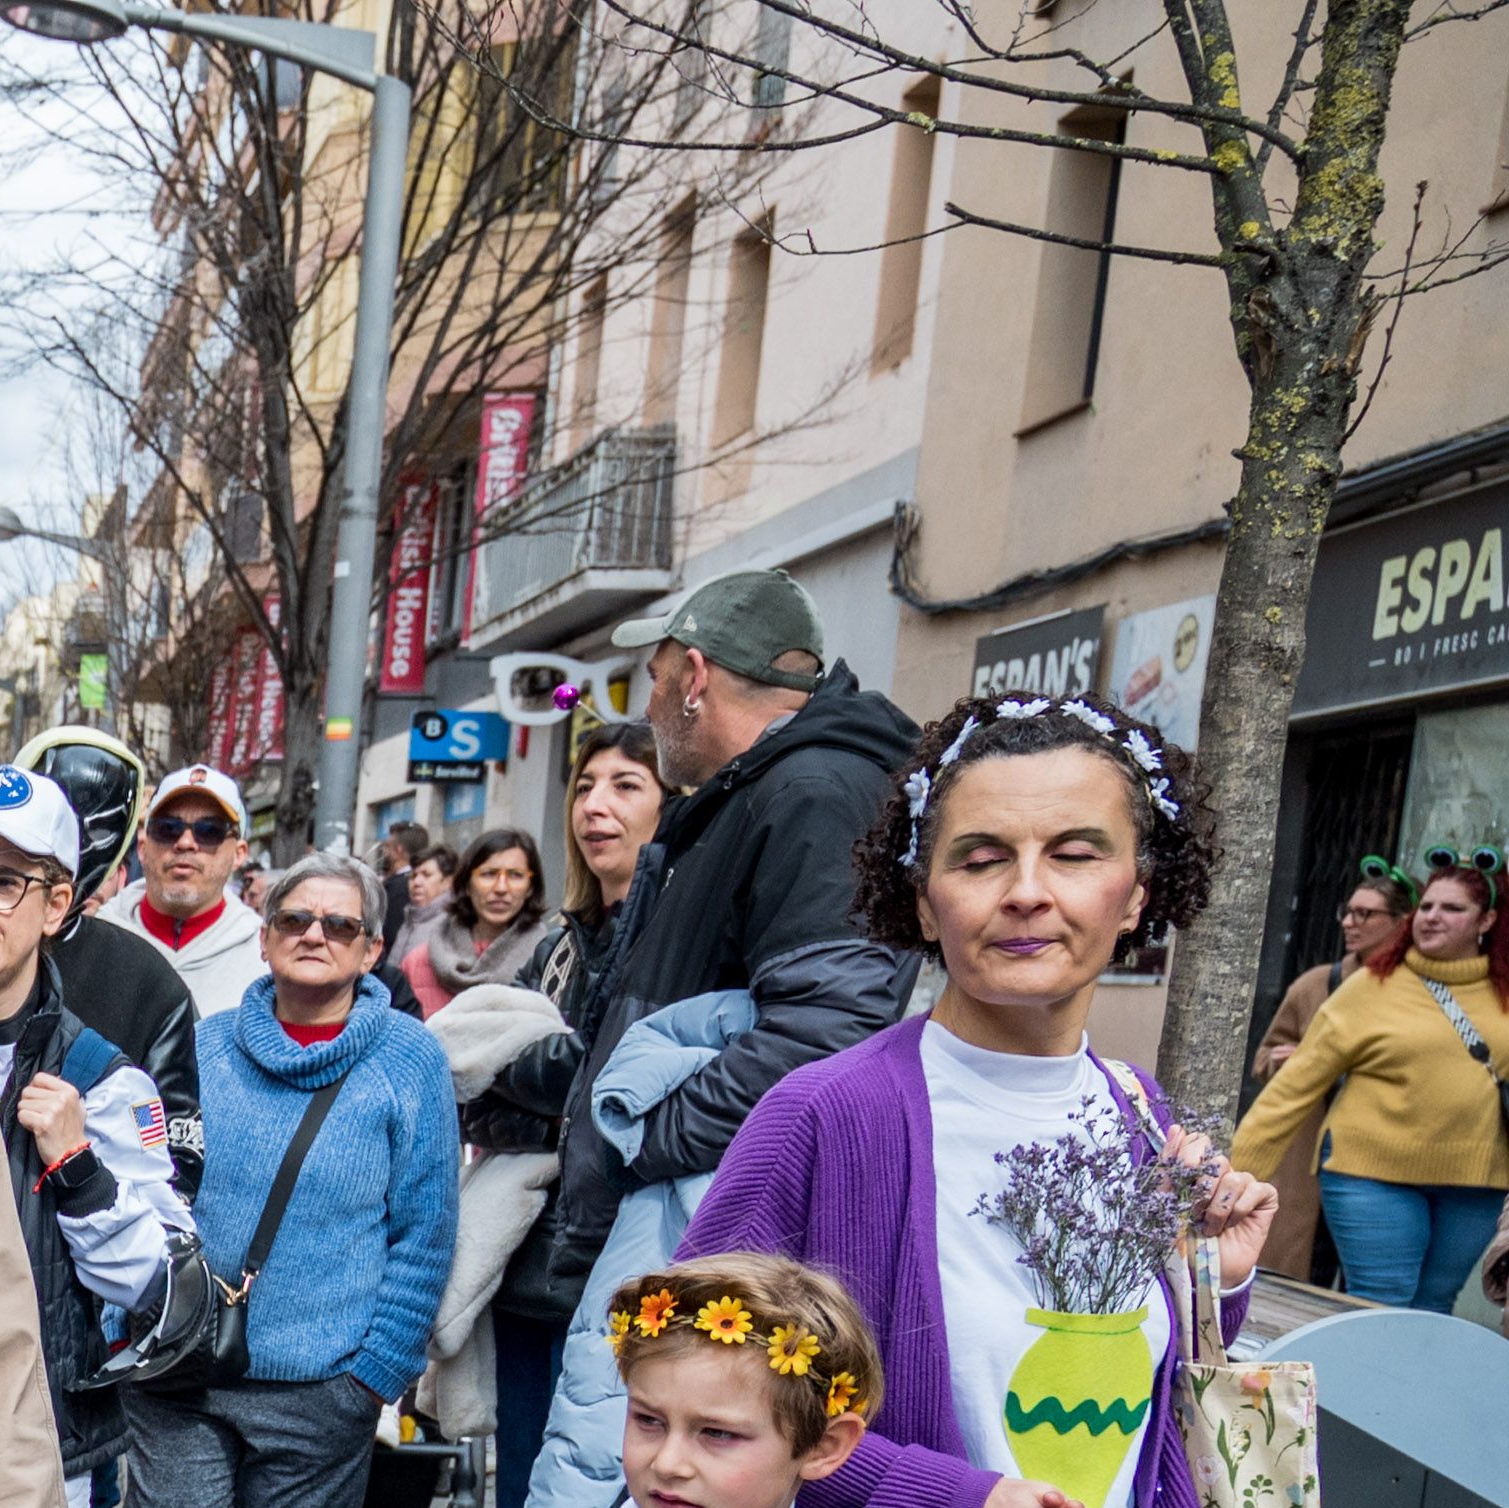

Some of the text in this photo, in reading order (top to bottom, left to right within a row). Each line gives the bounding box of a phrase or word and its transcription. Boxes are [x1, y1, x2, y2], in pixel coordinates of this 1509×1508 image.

[1372, 527, 1509, 641] ESPA
[389, 587, 422, 678] House
[1433, 630, 1478, 658] FRESC
[1487, 623, 1509, 646] CA
[974, 636, 1094, 698] ESPAN'S
[425, 717, 481, 760] B S
